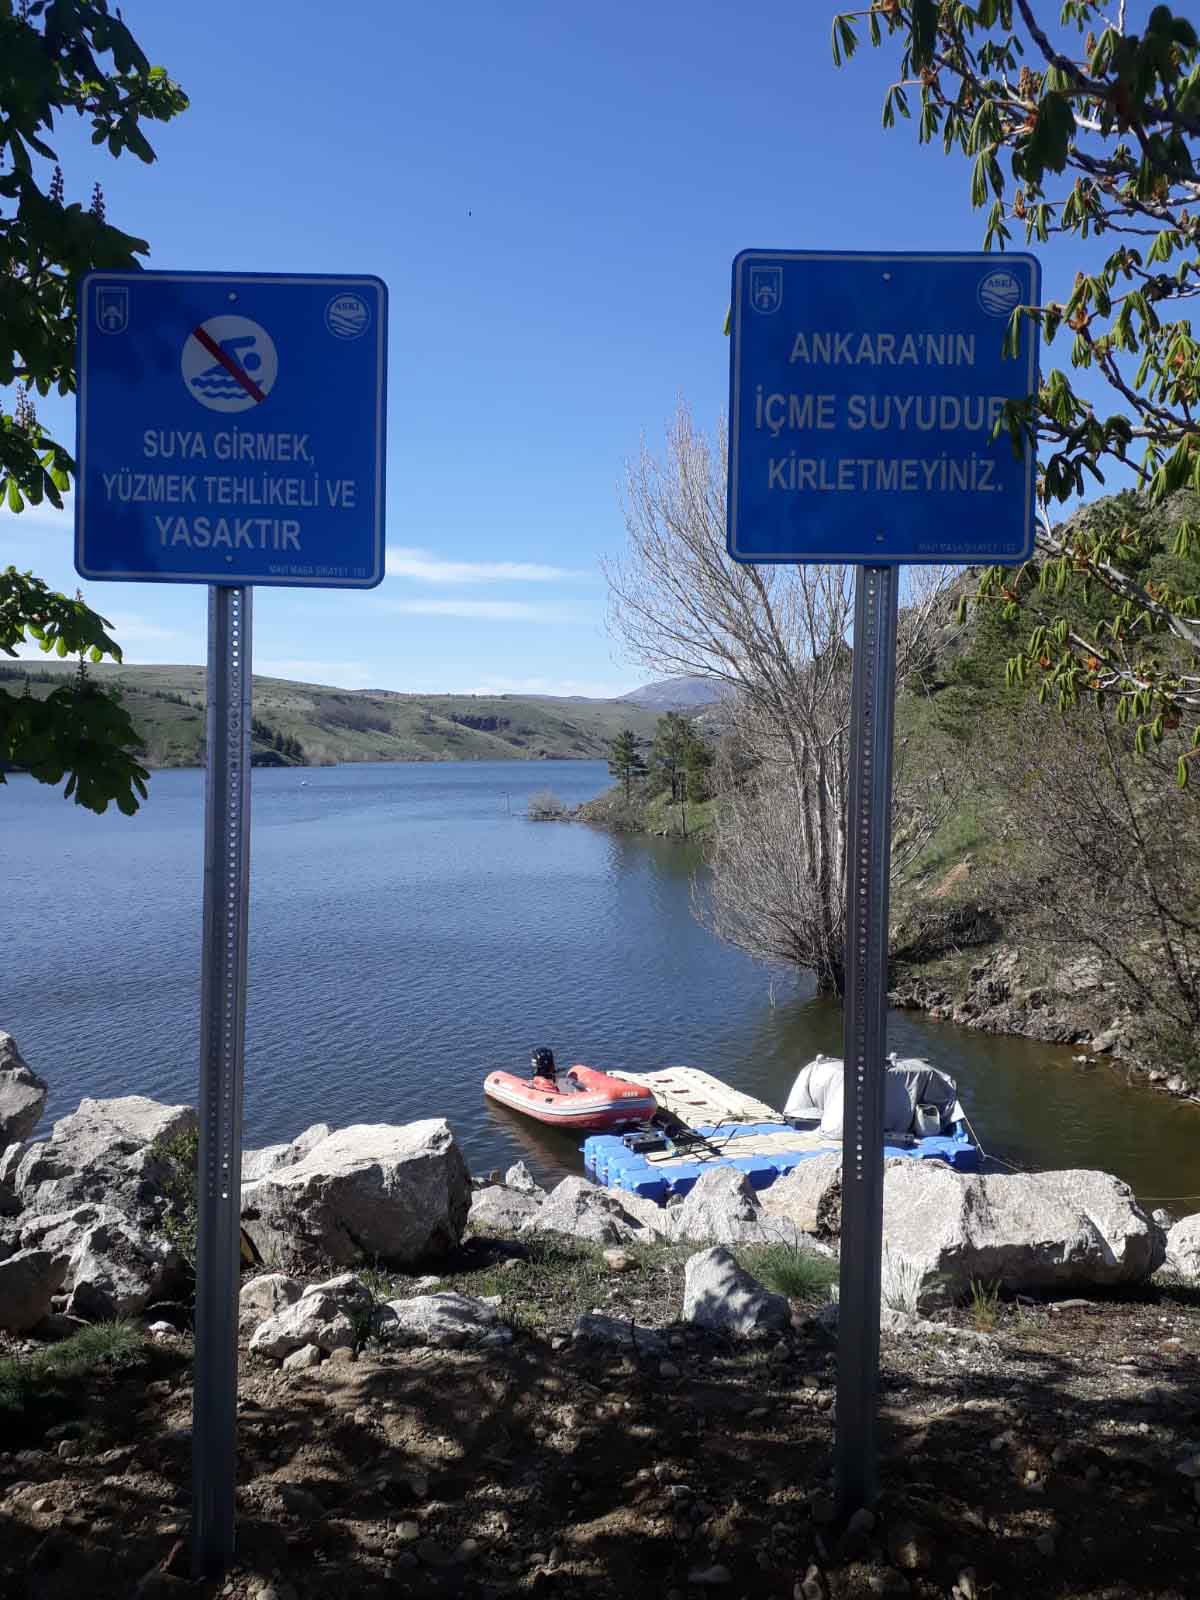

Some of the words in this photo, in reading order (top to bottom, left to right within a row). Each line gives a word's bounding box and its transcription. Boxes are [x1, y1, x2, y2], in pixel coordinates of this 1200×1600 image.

[789, 332, 975, 366] ANKARA'NIN
[754, 384, 836, 438] İÇME
[846, 395, 1009, 432] SUYUDUR
[143, 429, 207, 459] SUYA
[213, 426, 315, 465] GİRMEK,
[103, 467, 198, 503] YÜZMEK
[203, 471, 320, 507] TEHLİKELİ
[326, 479, 356, 508] VE
[767, 451, 1004, 492] KİRLETMEYİNİZ.
[155, 515, 302, 551] YASAKTIR
